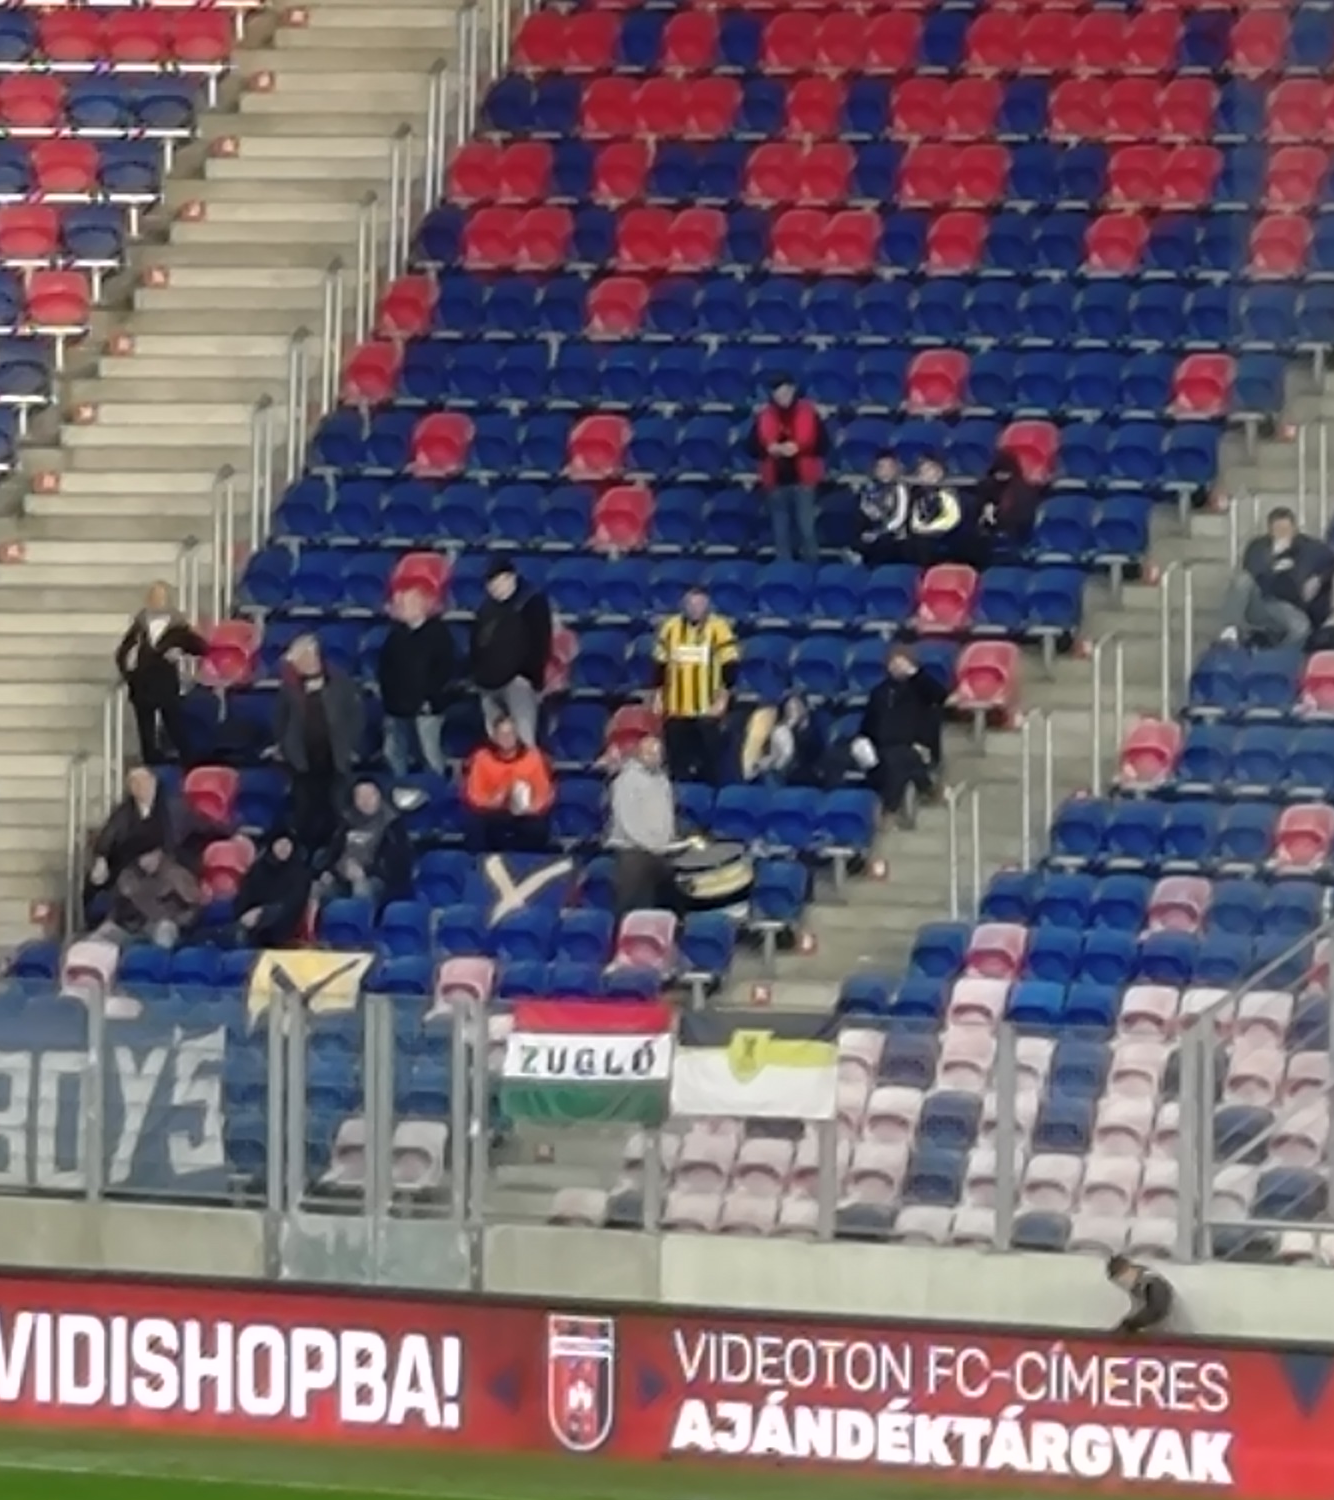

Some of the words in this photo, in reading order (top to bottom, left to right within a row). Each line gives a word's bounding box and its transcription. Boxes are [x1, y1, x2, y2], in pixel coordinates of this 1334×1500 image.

[520, 1039, 656, 1077] ZUGLÓ
[673, 1328, 913, 1392] VIDEOTON
[926, 1340, 1231, 1414] FC-CÍMERES
[671, 1392, 1233, 1485] AJÁNDÉKTÁRGYAK
